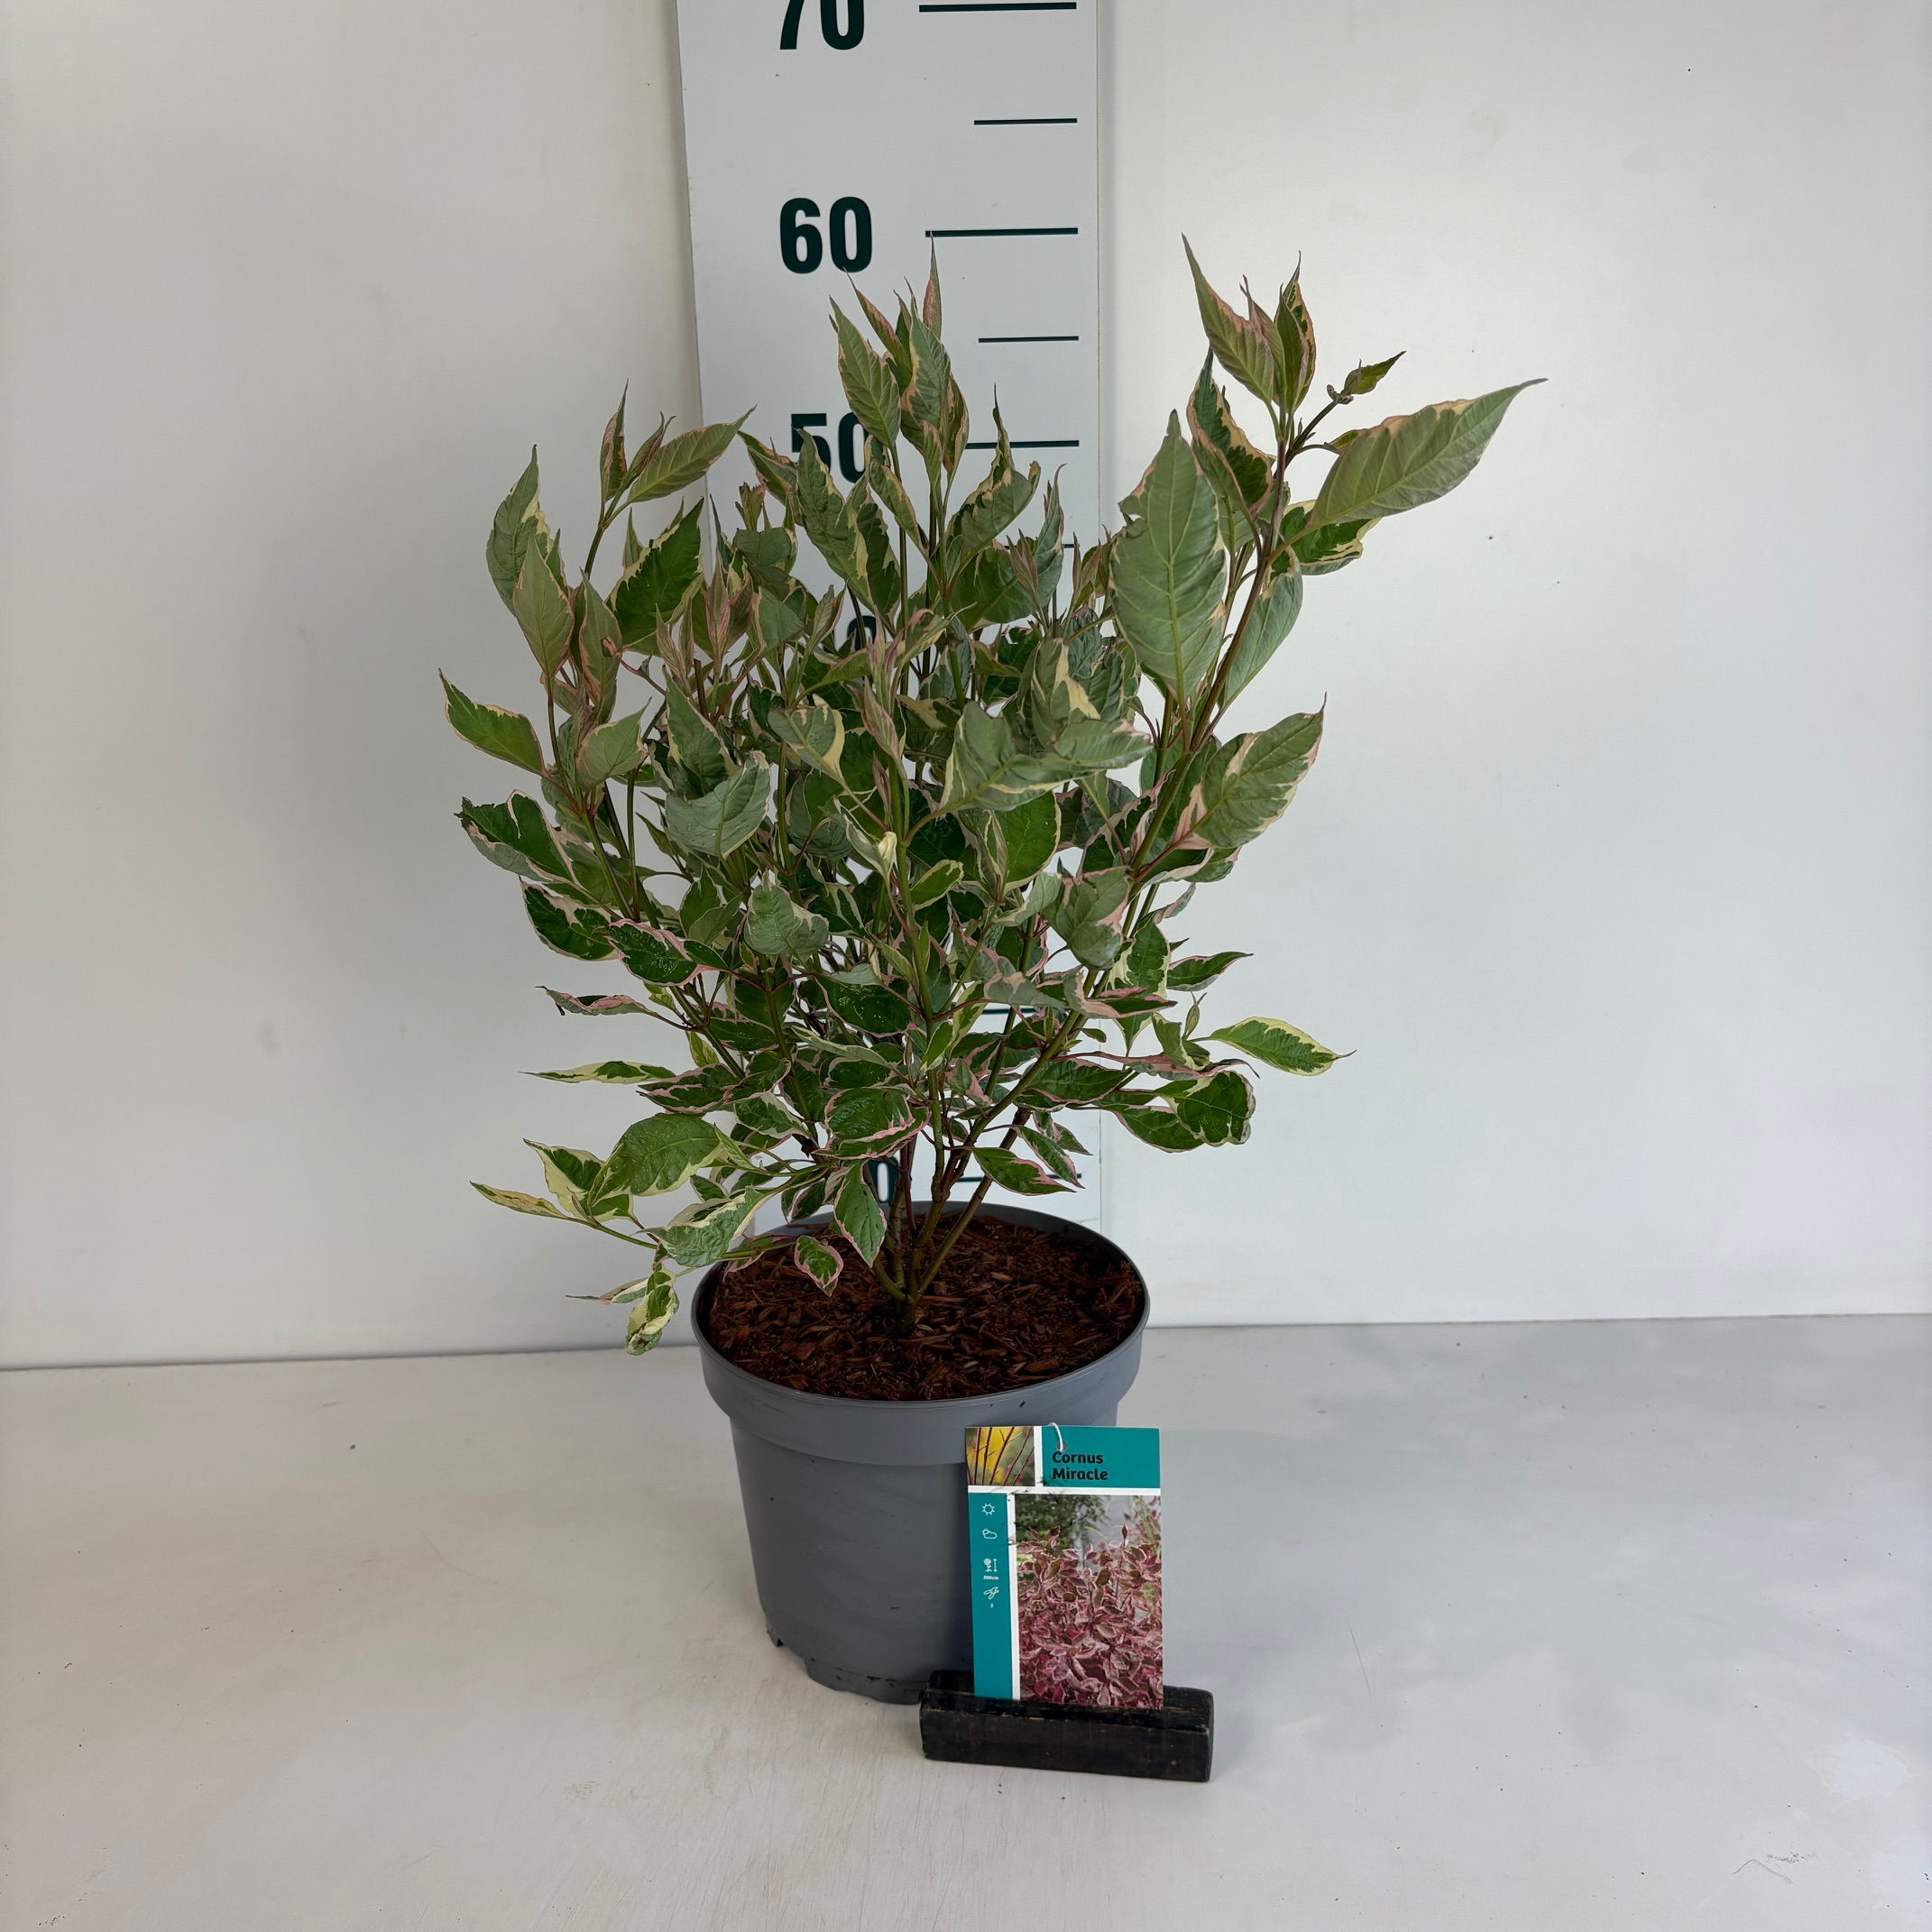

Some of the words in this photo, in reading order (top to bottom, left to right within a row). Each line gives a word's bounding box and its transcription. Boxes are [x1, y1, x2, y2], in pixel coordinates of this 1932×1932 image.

[779, 0, 865, 51] 70
[779, 196, 873, 274] 60
[1052, 1451, 1104, 1465] Cornus
[1052, 1467, 1109, 1481] Miracle
